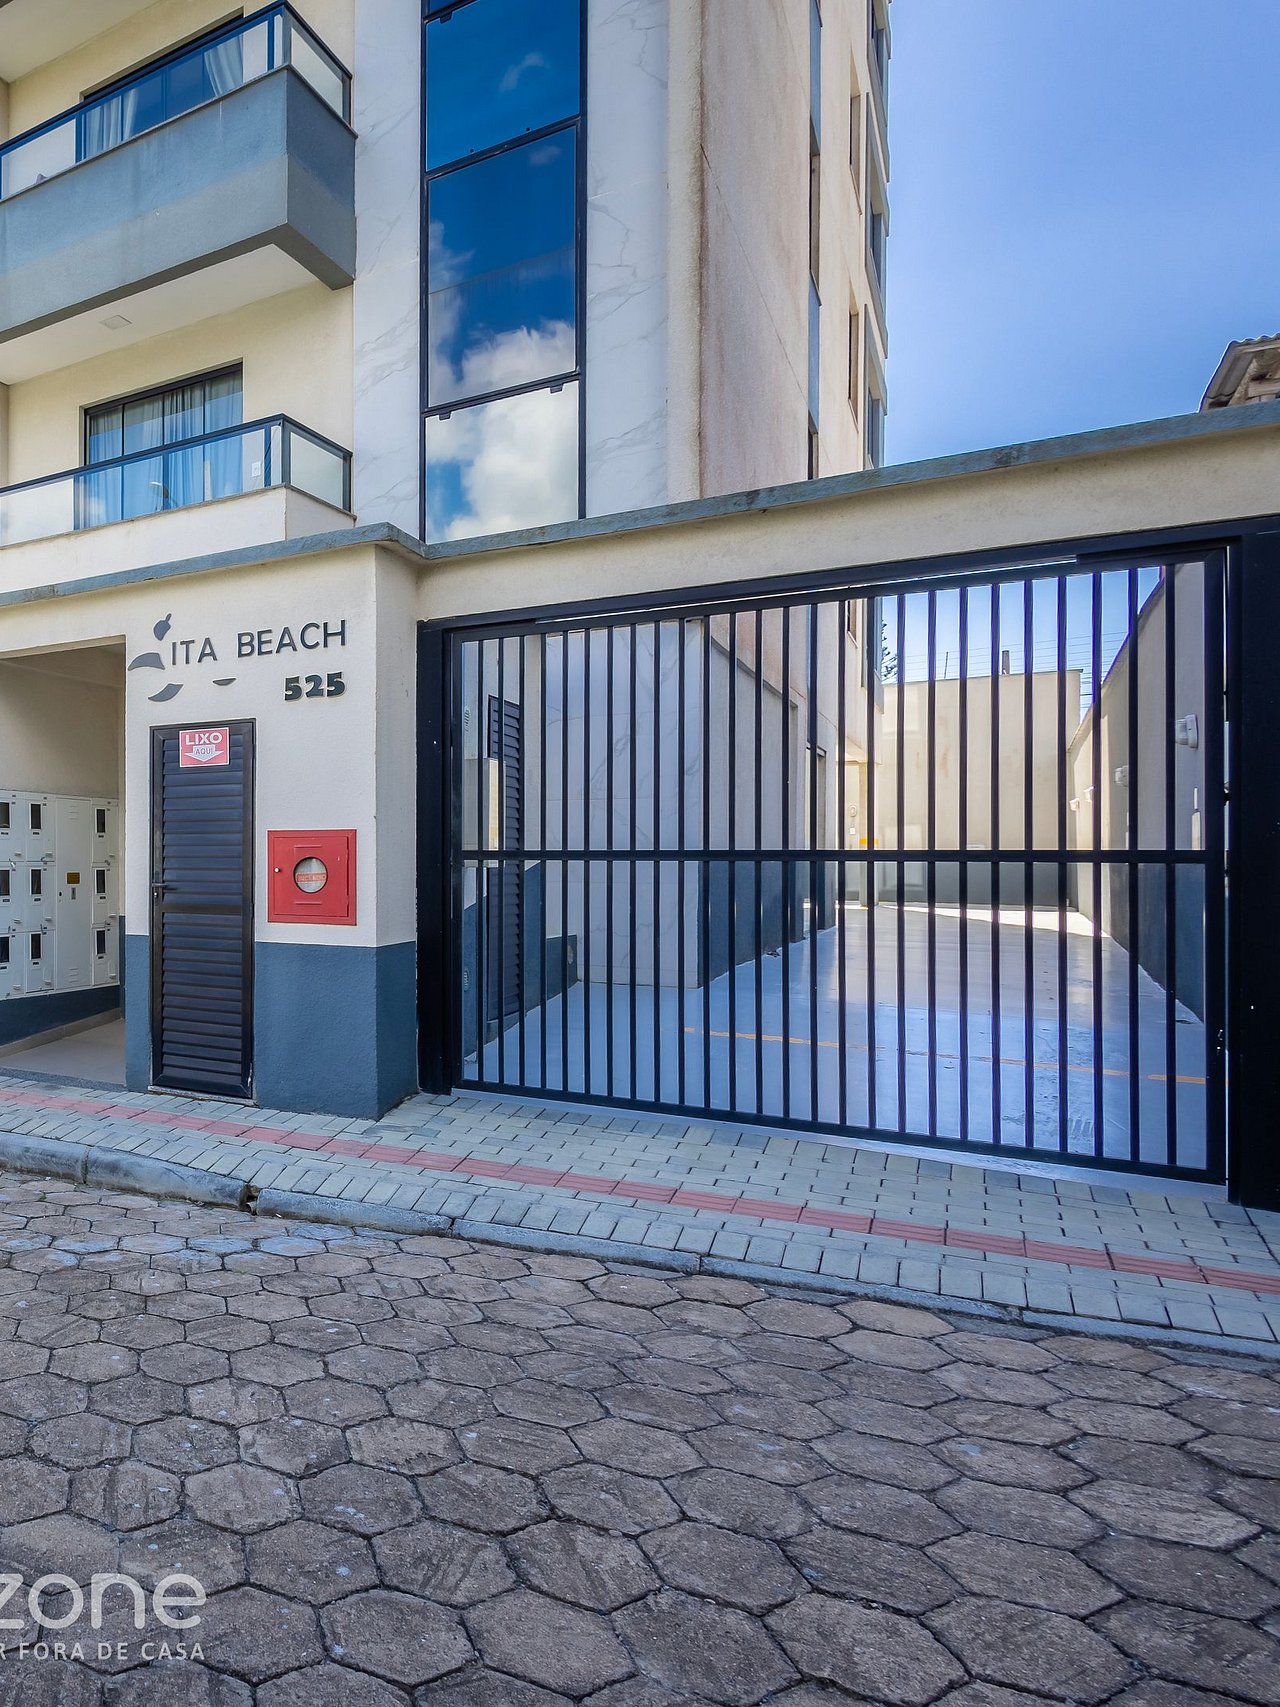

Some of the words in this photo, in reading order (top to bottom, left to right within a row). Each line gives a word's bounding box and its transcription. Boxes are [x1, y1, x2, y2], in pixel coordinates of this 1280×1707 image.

[171, 637, 218, 666] ITA
[236, 619, 347, 659] BEACH
[284, 672, 346, 701] 525
[185, 732, 223, 745] LIXO
